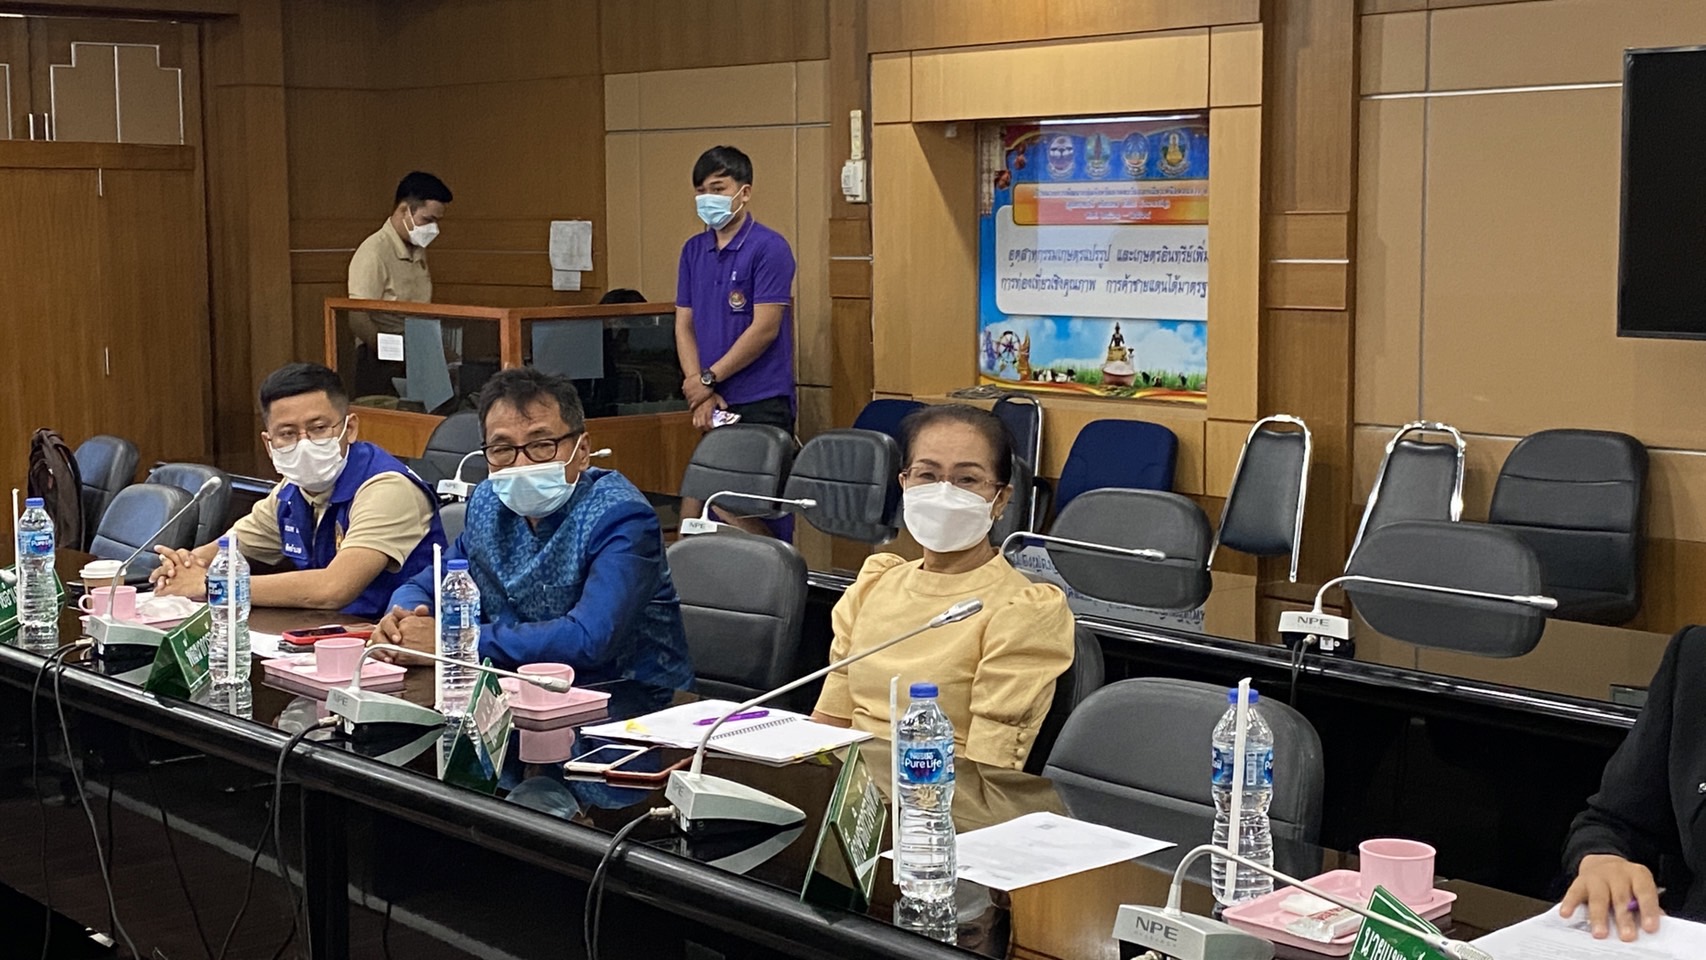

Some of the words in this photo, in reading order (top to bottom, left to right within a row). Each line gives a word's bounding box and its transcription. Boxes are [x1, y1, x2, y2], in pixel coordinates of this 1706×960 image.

[1297, 616, 1330, 627] NPE
[905, 758, 925, 769] Pure
[926, 758, 942, 772] Life
[1136, 916, 1179, 942] NPE
